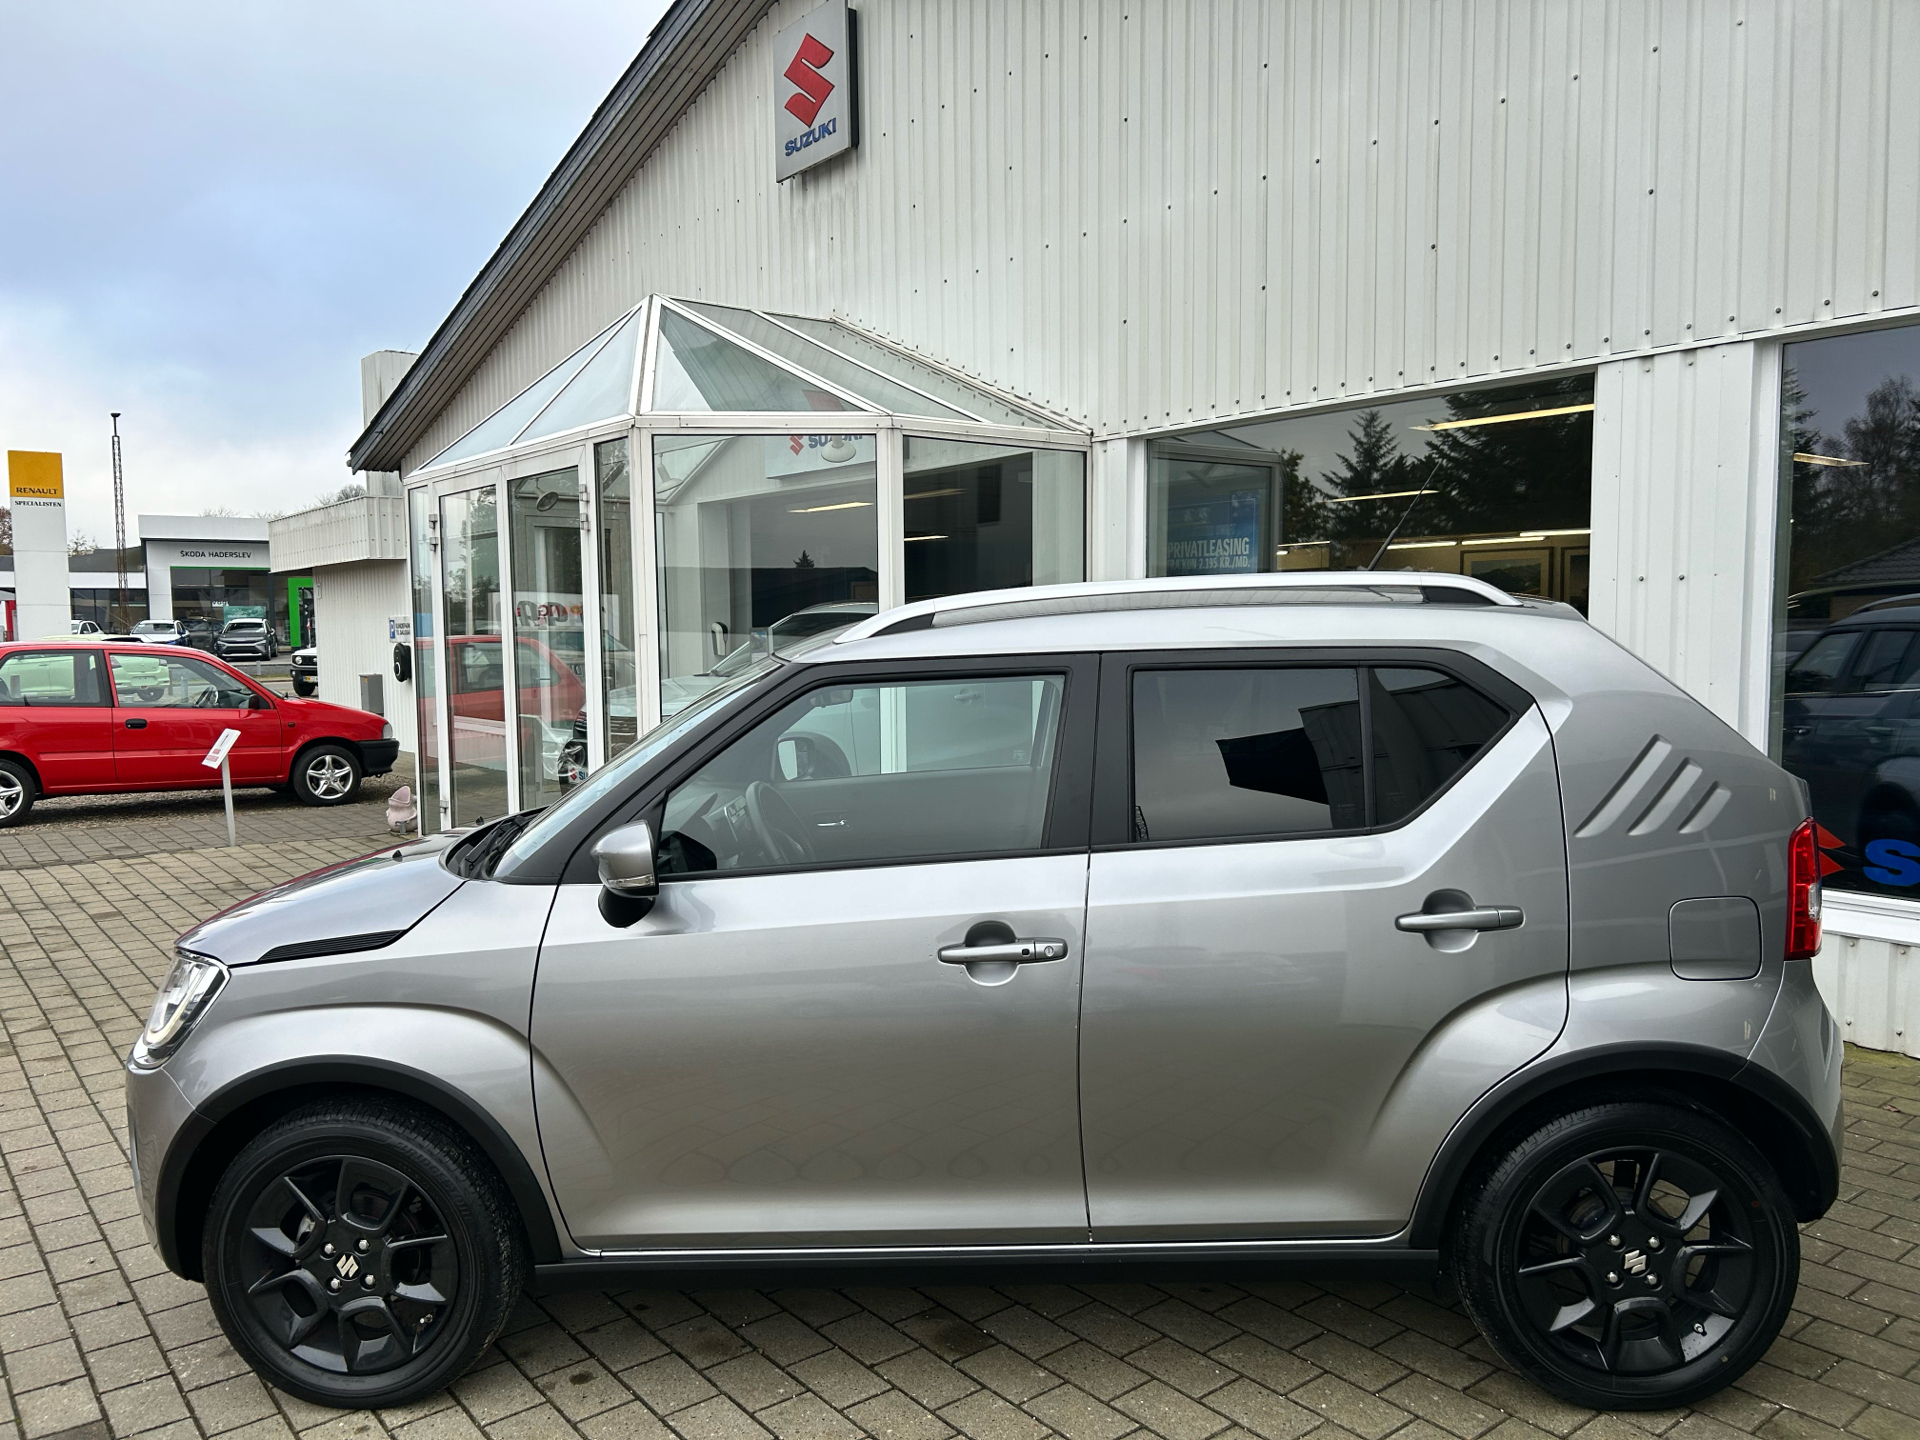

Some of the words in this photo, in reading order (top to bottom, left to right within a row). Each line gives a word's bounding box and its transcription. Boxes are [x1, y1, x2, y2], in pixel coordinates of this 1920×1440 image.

[784, 117, 837, 157] SUZUKI
[15, 486, 59, 495] RENAULT
[14, 500, 62, 508] SPECIALISTEN
[1167, 537, 1250, 558] PRIVATLEASING
[180, 550, 206, 558] ŠKODA
[208, 551, 252, 559] HADERSLEV
[1181, 558, 1197, 570] KUN
